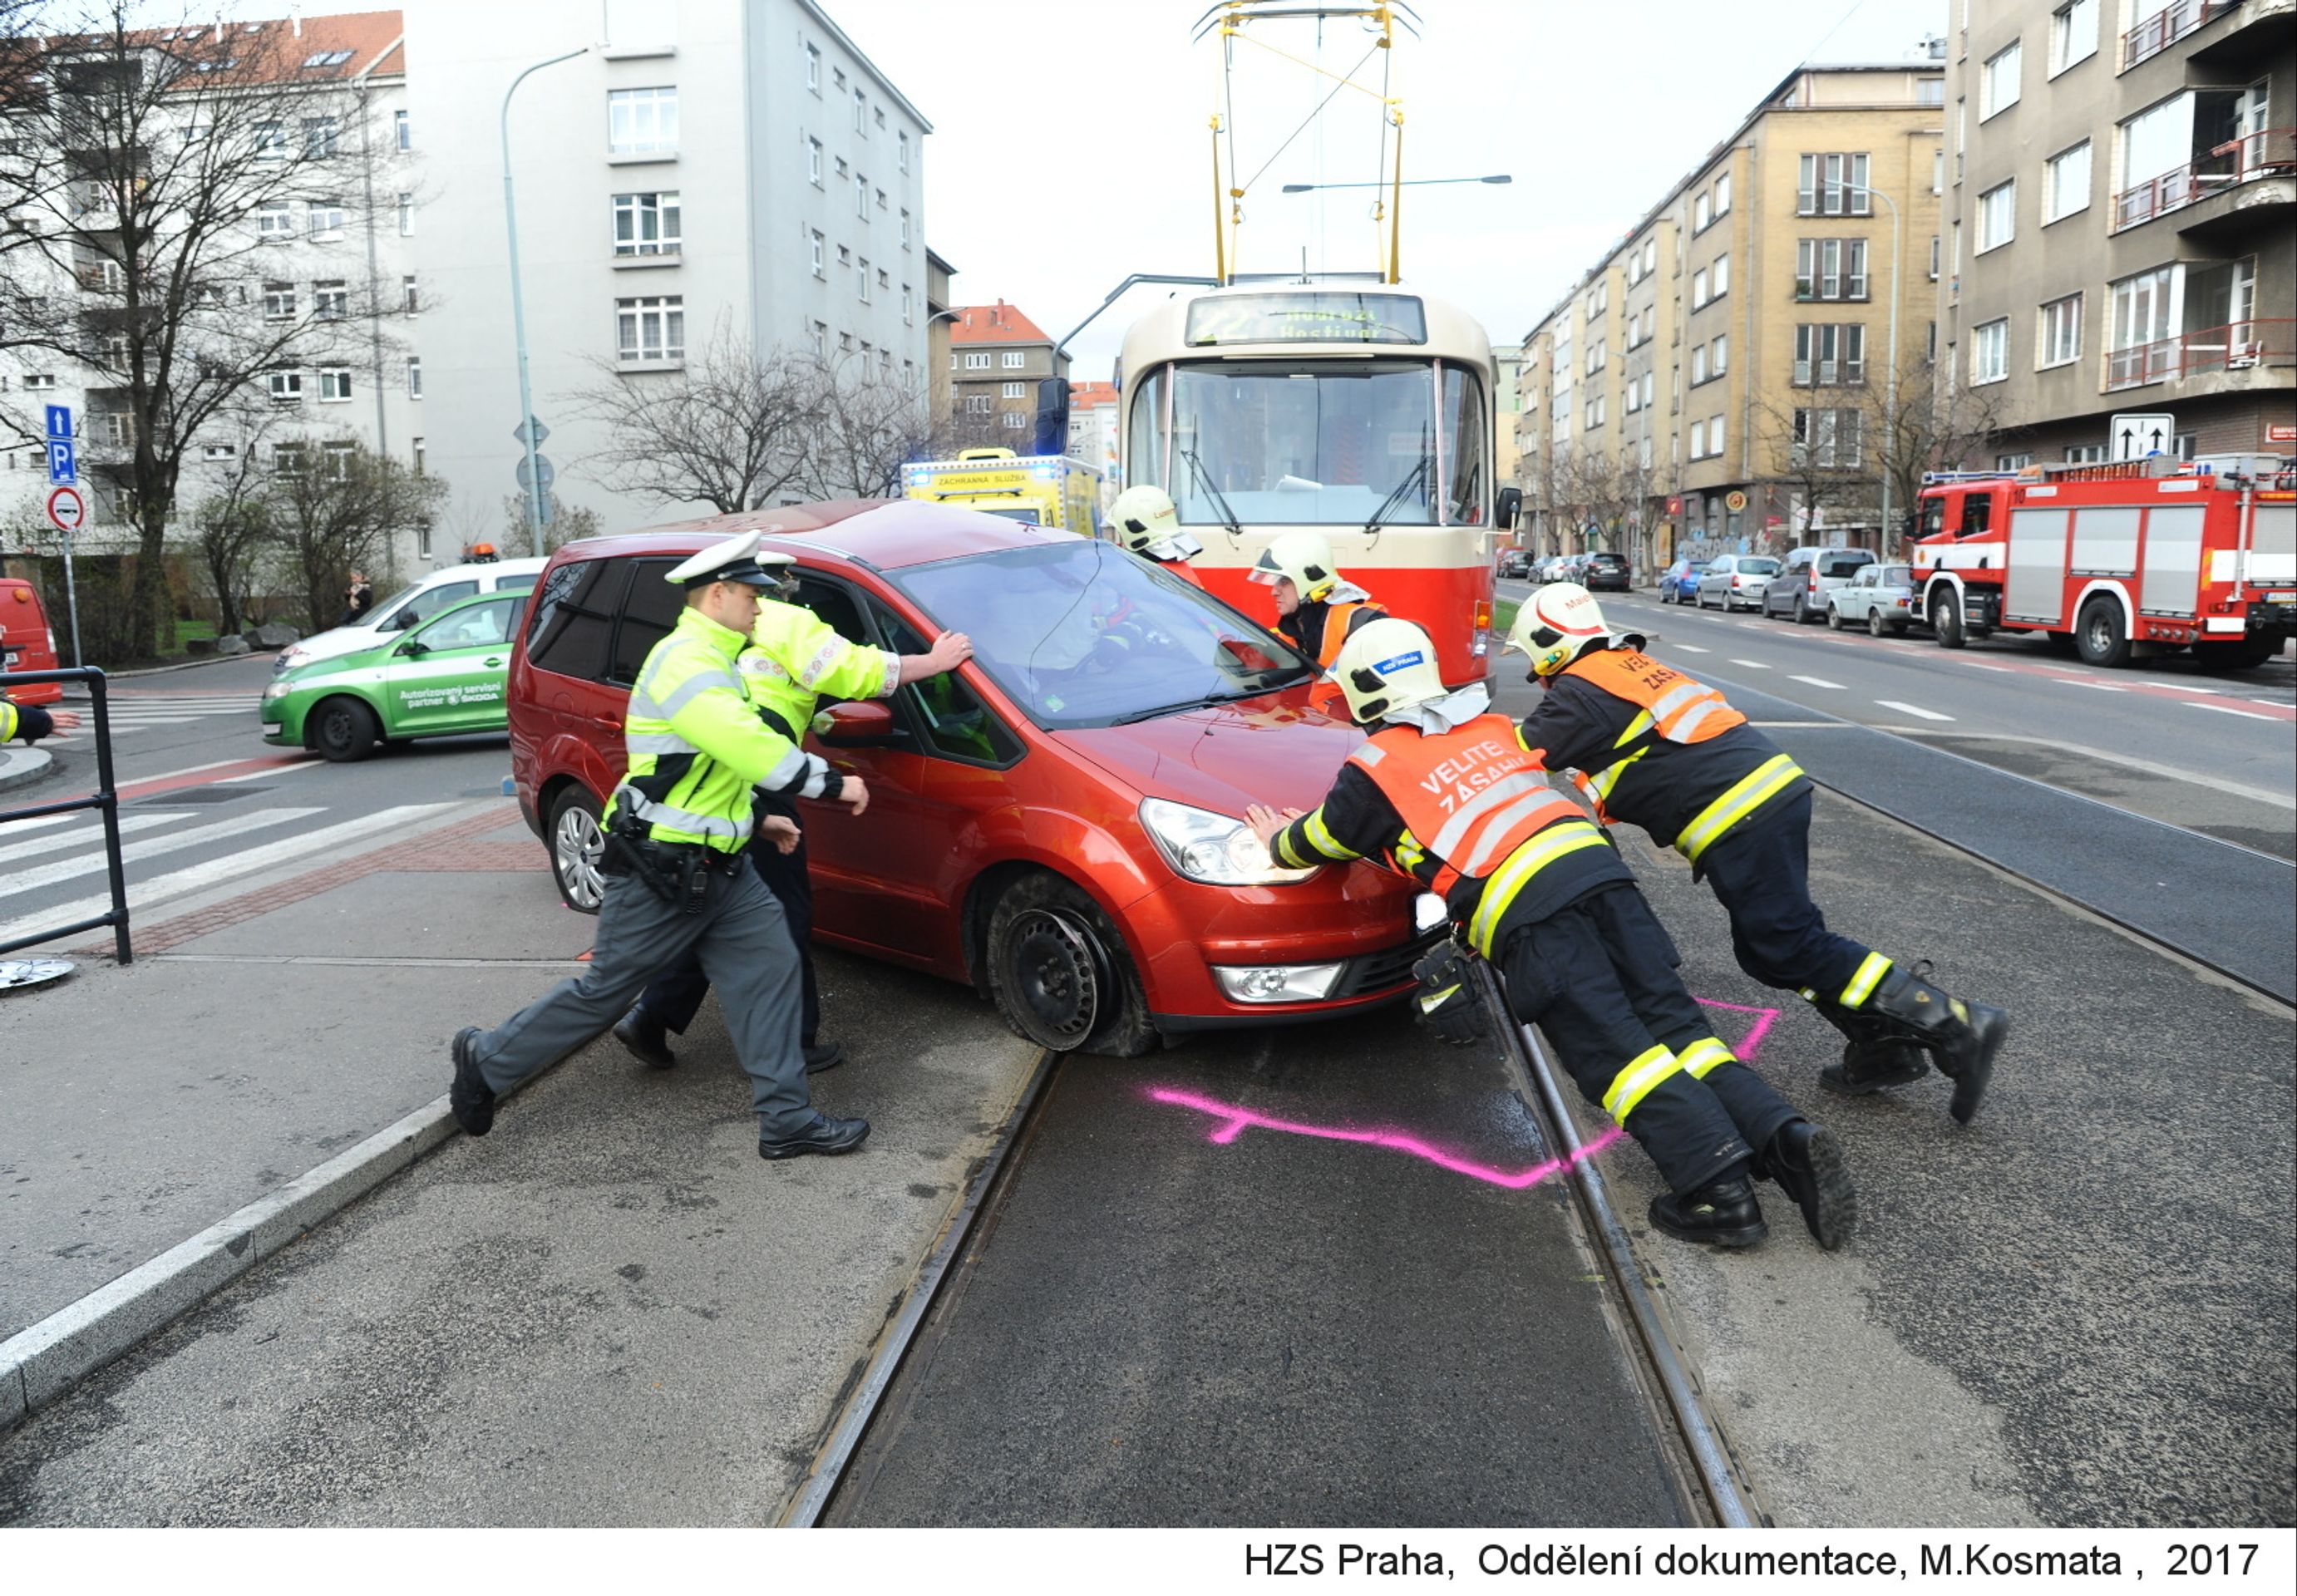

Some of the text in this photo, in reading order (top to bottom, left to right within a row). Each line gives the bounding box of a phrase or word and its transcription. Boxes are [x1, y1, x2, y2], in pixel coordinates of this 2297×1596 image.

[2014, 489, 2026, 505] 10
[400, 685, 462, 699] Autorizovaný
[407, 697, 444, 709] partner
